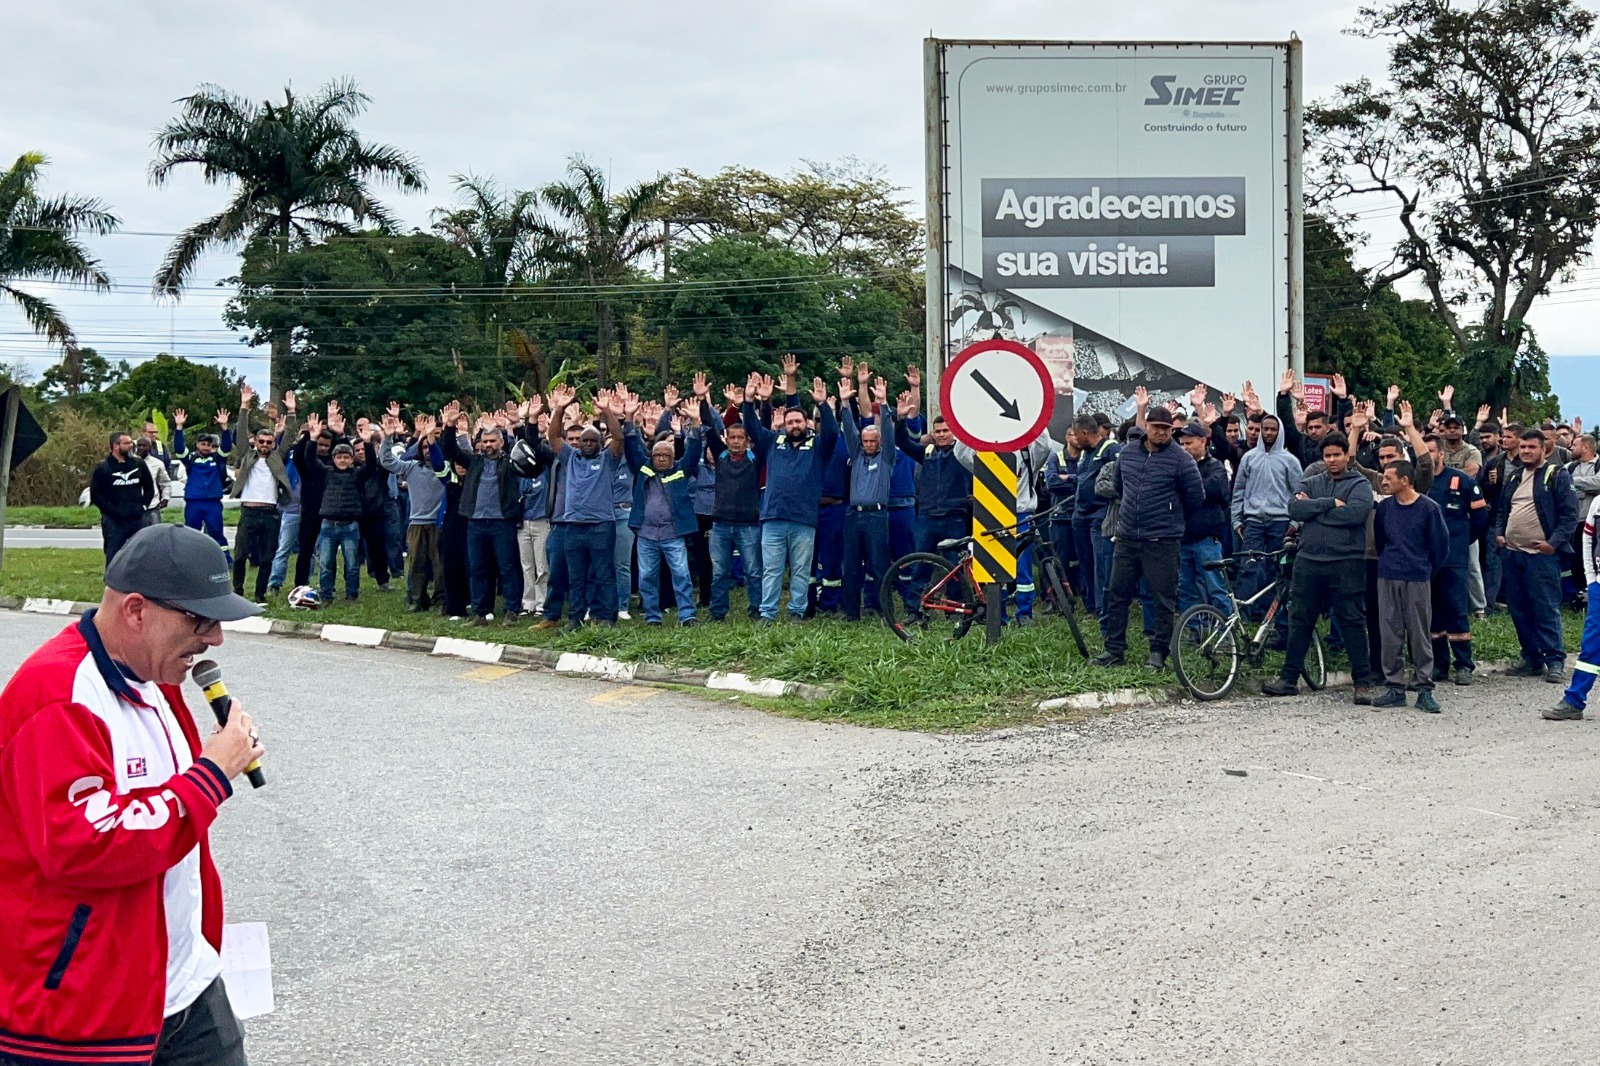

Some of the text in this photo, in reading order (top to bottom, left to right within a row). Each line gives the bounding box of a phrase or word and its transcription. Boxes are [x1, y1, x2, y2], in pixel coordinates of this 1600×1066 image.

[986, 82, 1127, 96] www.gruposimec.com.br
[1143, 75, 1245, 106] SIMEC
[1203, 75, 1247, 85] GRUPO
[1143, 122, 1204, 132] Construindo
[1216, 122, 1247, 132] futuro
[995, 187, 1236, 228] Agradecemos
[996, 243, 1168, 276] sua visita!
